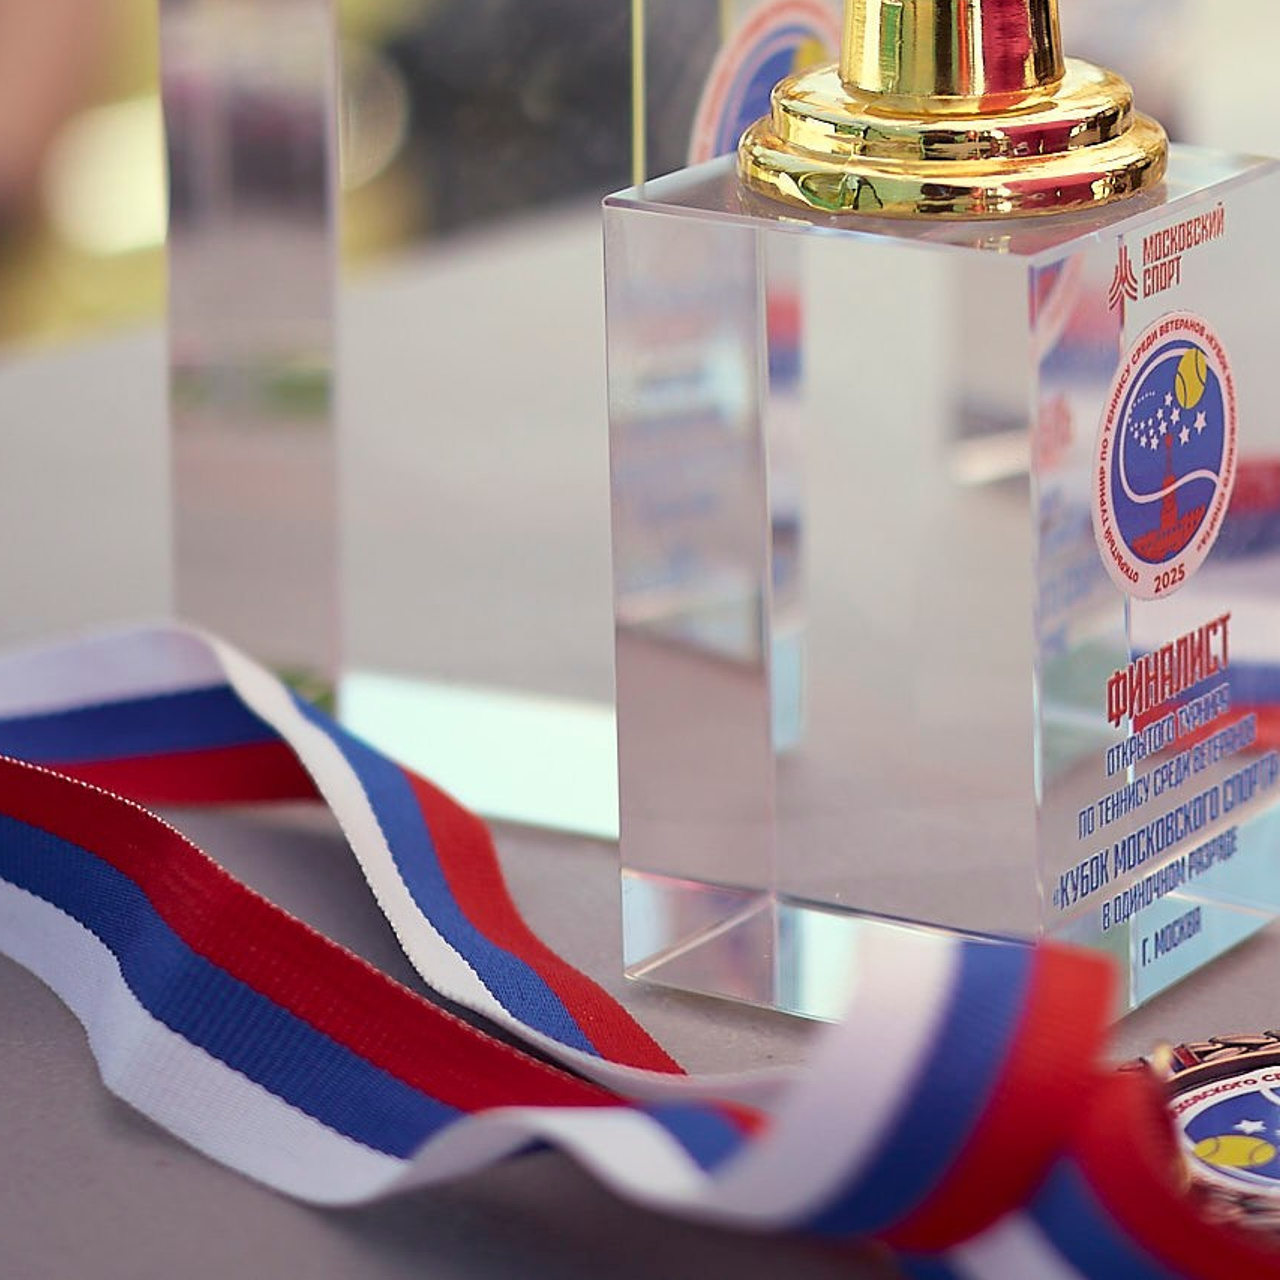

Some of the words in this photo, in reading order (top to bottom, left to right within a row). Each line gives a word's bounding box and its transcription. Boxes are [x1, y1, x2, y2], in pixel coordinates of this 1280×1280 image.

[1143, 201, 1225, 267] МОСКОВСКИЙ
[1143, 255, 1182, 299] СПОРТ
[1131, 330, 1158, 365] СРЕДИ
[1159, 318, 1206, 338] ВЕТЕРАНОВ
[1104, 363, 1131, 434] ТЕННИСУ
[1100, 438, 1109, 461] ПО
[1098, 466, 1109, 528] ТУРНИР
[1103, 525, 1139, 584] ОТКРЫТЫЙ
[1153, 563, 1186, 594] 2025
[1106, 610, 1231, 729] ФИНАЛИСТ
[1107, 713, 1175, 777] ОТКРЫТОГО
[1078, 806, 1095, 840] ПО
[1098, 772, 1150, 828] ТЕННИСУ
[1153, 749, 1191, 797] СРЕДИ
[1113, 785, 1220, 879] МОСКОВСКОГО
[1102, 901, 1110, 931] В
[1142, 937, 1151, 967] Г.
